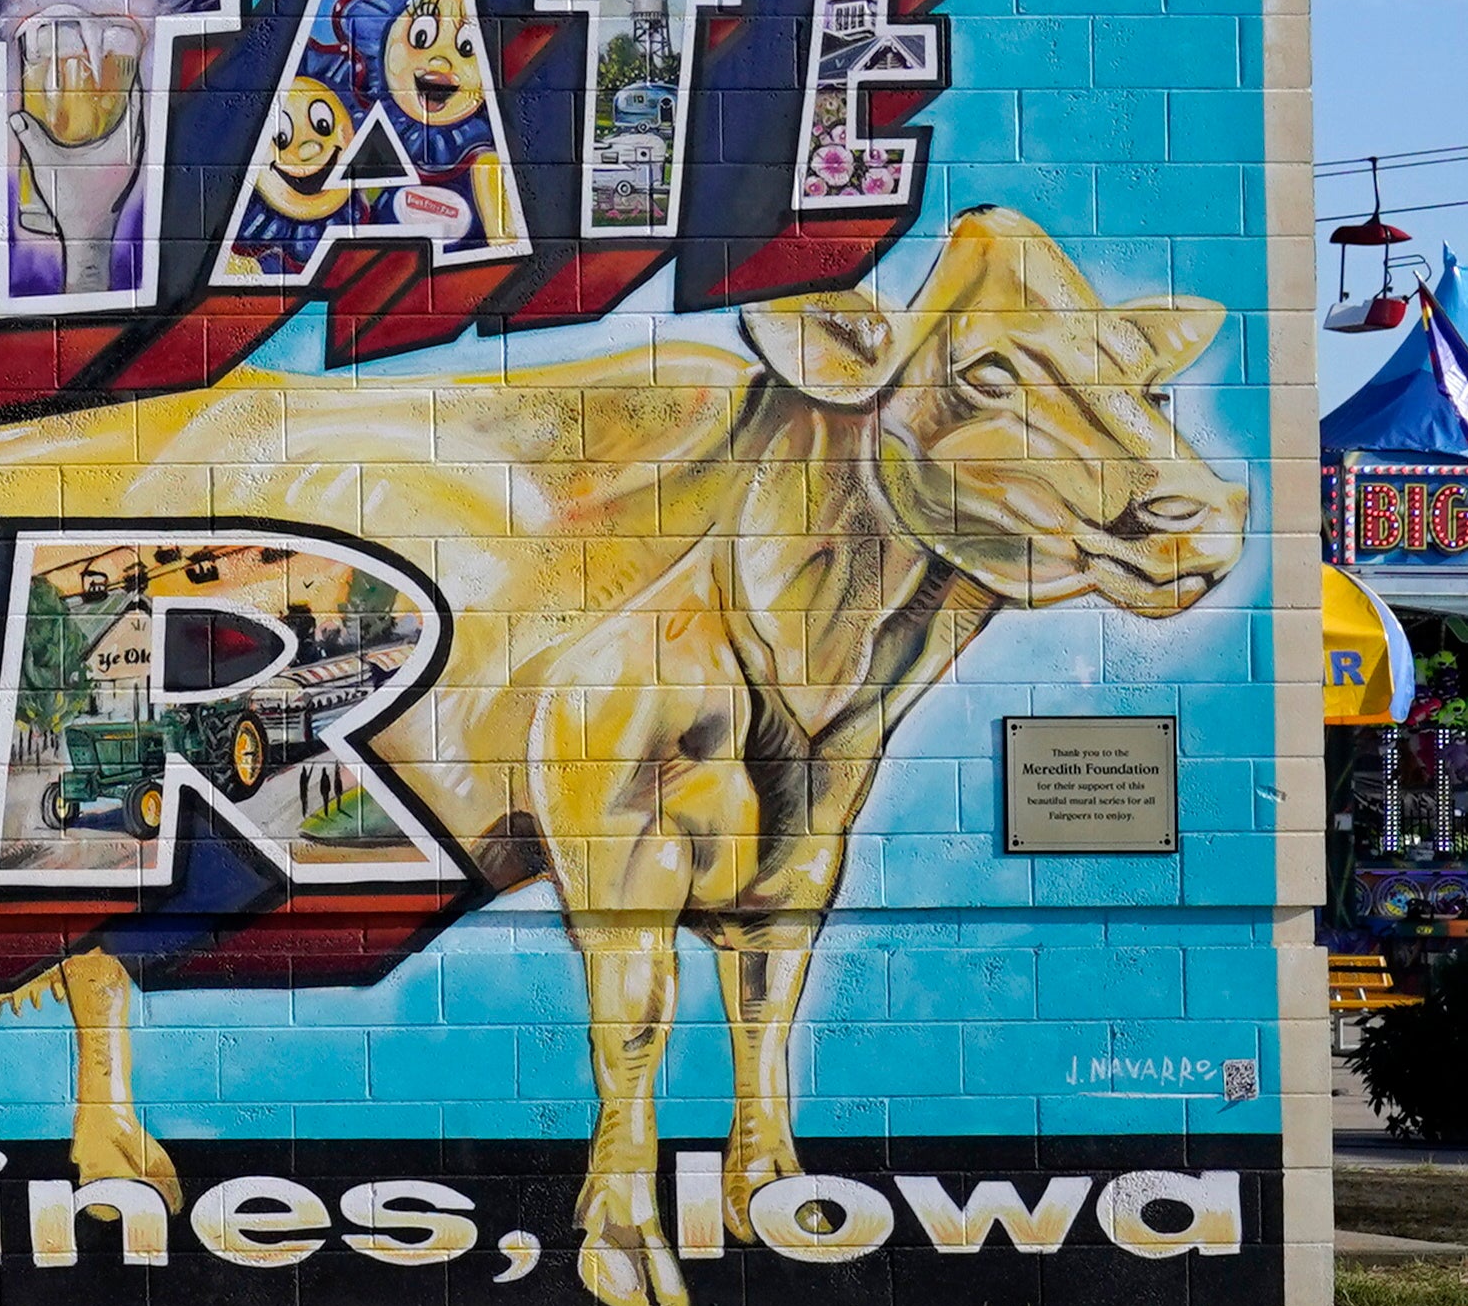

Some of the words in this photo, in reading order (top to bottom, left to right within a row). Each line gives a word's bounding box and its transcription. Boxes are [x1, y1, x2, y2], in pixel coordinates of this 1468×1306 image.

[1360, 483, 1468, 552] BIG
[1051, 748, 1080, 758] Thank
[1082, 750, 1100, 759] you
[1102, 749, 1112, 758] to
[1115, 748, 1130, 758] the
[1022, 763, 1082, 776] Meredith
[1085, 763, 1160, 776] Foundation
[1037, 782, 1051, 791] for
[1054, 781, 1075, 791] their
[1077, 782, 1114, 793] support
[1116, 781, 1126, 791] of
[1128, 781, 1145, 791] this
[1027, 797, 1067, 806] beautiful
[1069, 797, 1096, 806] mural
[1099, 797, 1125, 806] series
[1127, 797, 1141, 806] for
[1144, 796, 1156, 806] all
[1049, 811, 1092, 822] Fairgoers
[1094, 812, 1104, 821] to
[1106, 812, 1135, 822] enjoy.
[1089, 1055, 1218, 1088] NAVARRO
[674, 1150, 1244, 1264] Iowa
